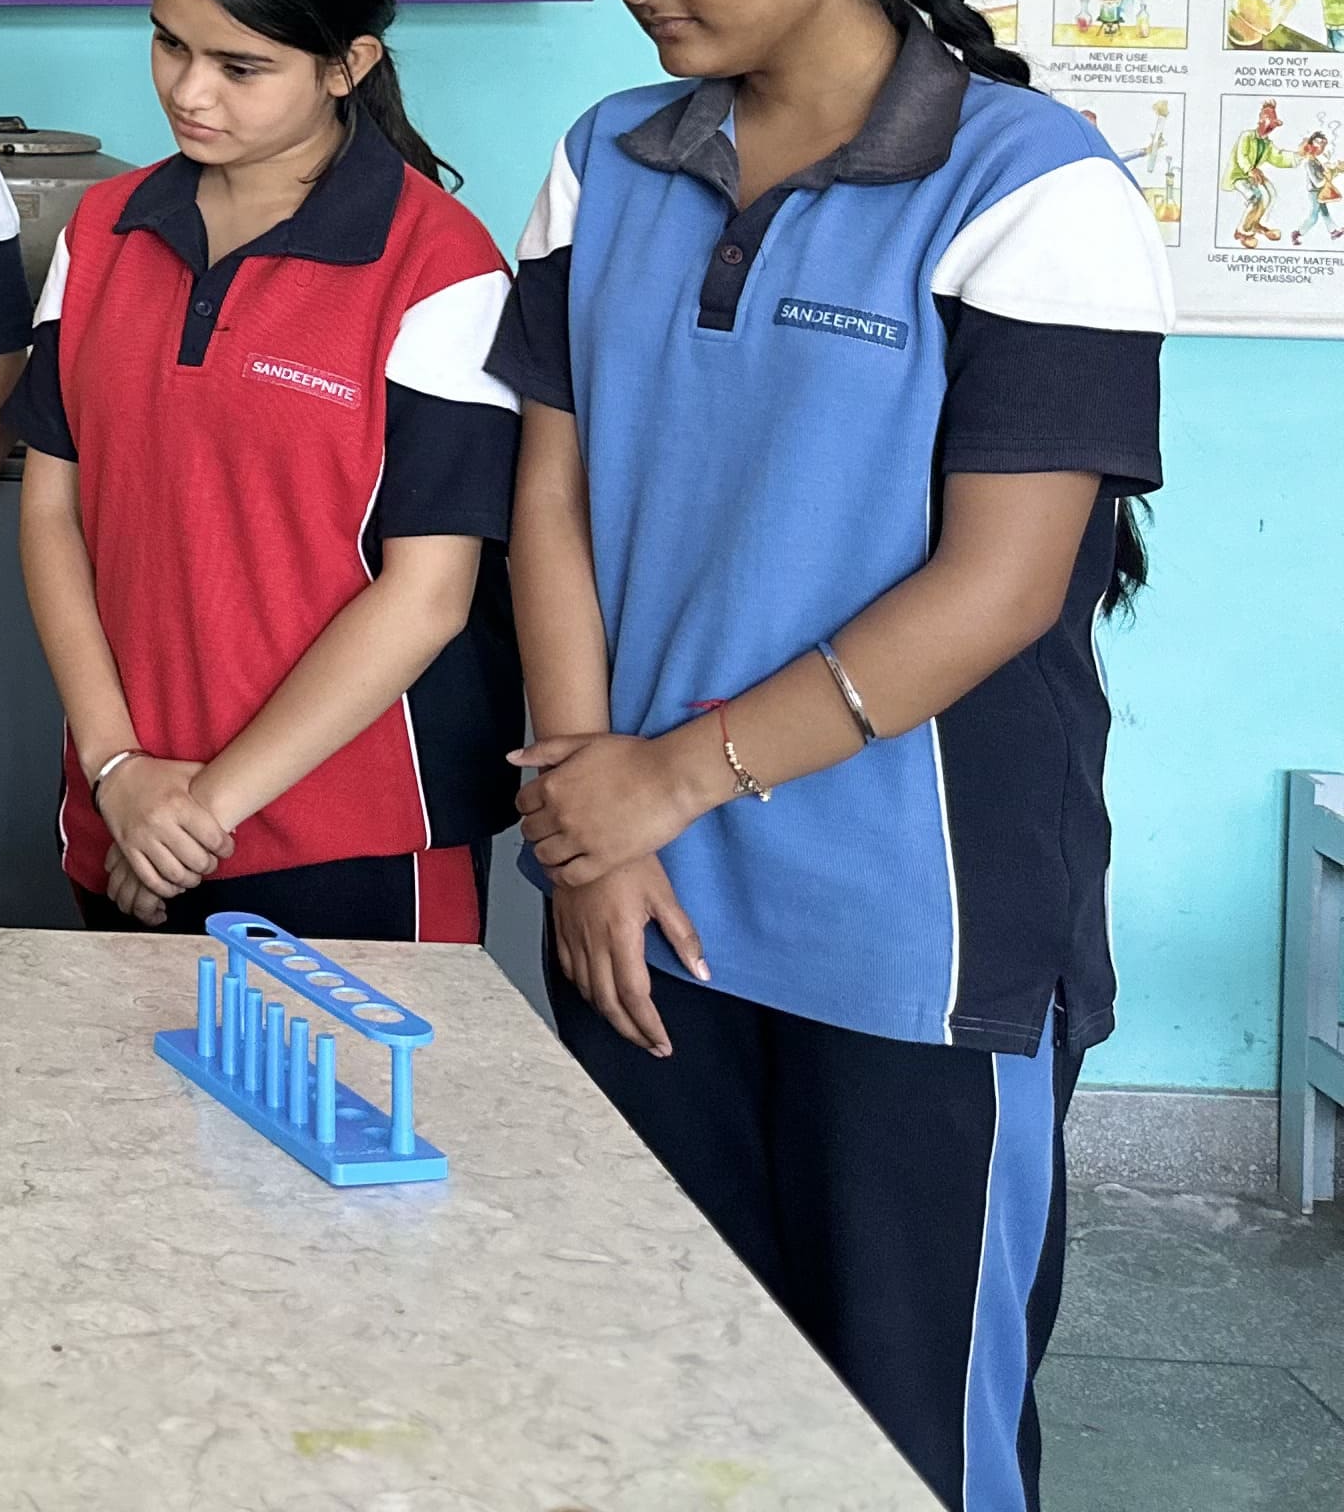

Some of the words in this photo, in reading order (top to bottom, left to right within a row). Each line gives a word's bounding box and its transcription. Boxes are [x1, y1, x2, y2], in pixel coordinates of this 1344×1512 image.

[1268, 57, 1284, 66] DO
[1286, 57, 1308, 66] NOT
[1235, 67, 1257, 76] ADD
[1259, 68, 1295, 77] WATER
[1298, 69, 1312, 77] TO
[1235, 78, 1257, 87] ADD
[1259, 78, 1283, 87] ACID
[1285, 79, 1299, 88] TO
[1208, 254, 1229, 262] USE
[1232, 255, 1301, 265] LABORATORY
[1227, 264, 1254, 272] WITH
[781, 304, 897, 341] SANDEEPNITE
[252, 361, 356, 401] SANDEEPNITE
